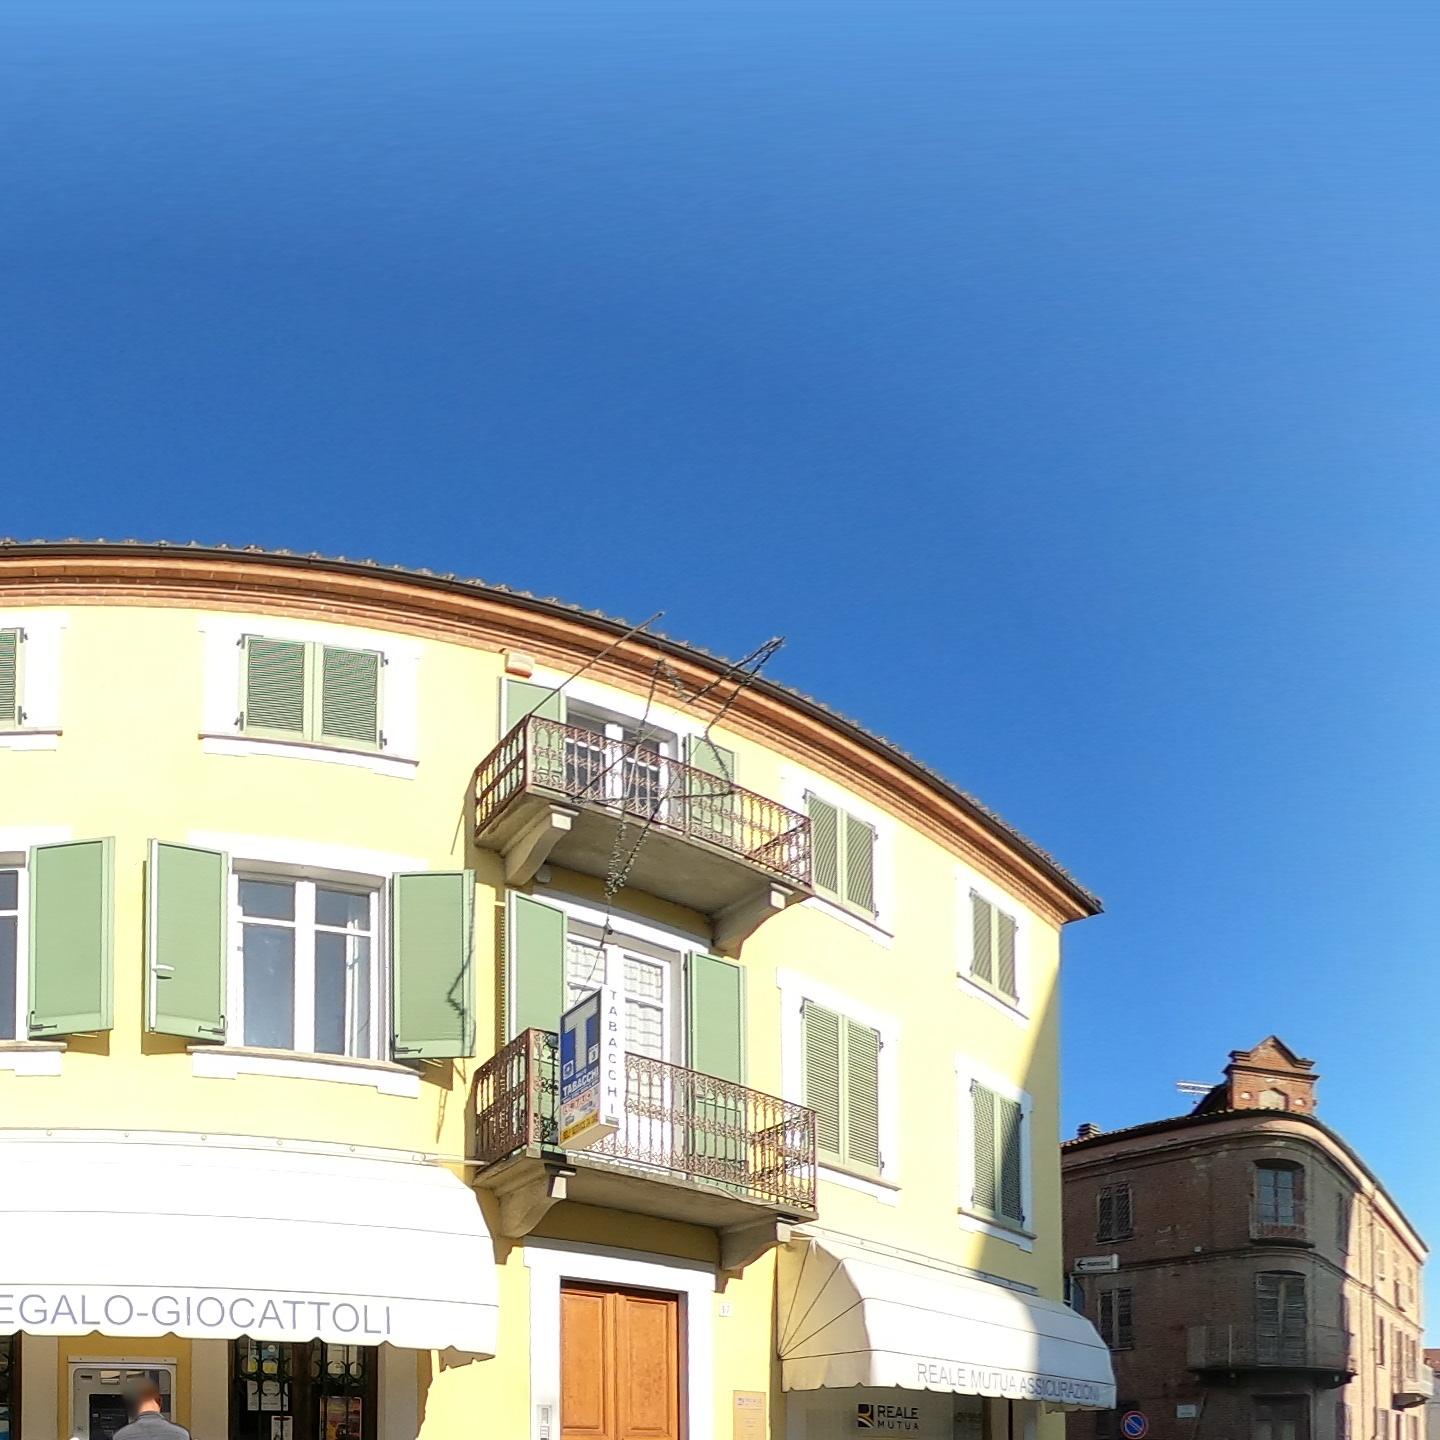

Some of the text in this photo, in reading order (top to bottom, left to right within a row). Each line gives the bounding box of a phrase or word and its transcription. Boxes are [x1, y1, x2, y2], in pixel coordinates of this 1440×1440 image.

[607, 990, 618, 1114] TABACCHI
[562, 1066, 600, 1097] TABACCHI
[917, 1363, 967, 1387] REALE
[970, 1369, 1017, 1393] MUTUA
[877, 1404, 919, 1420] REALE
[877, 1420, 920, 1430] MUTUA
